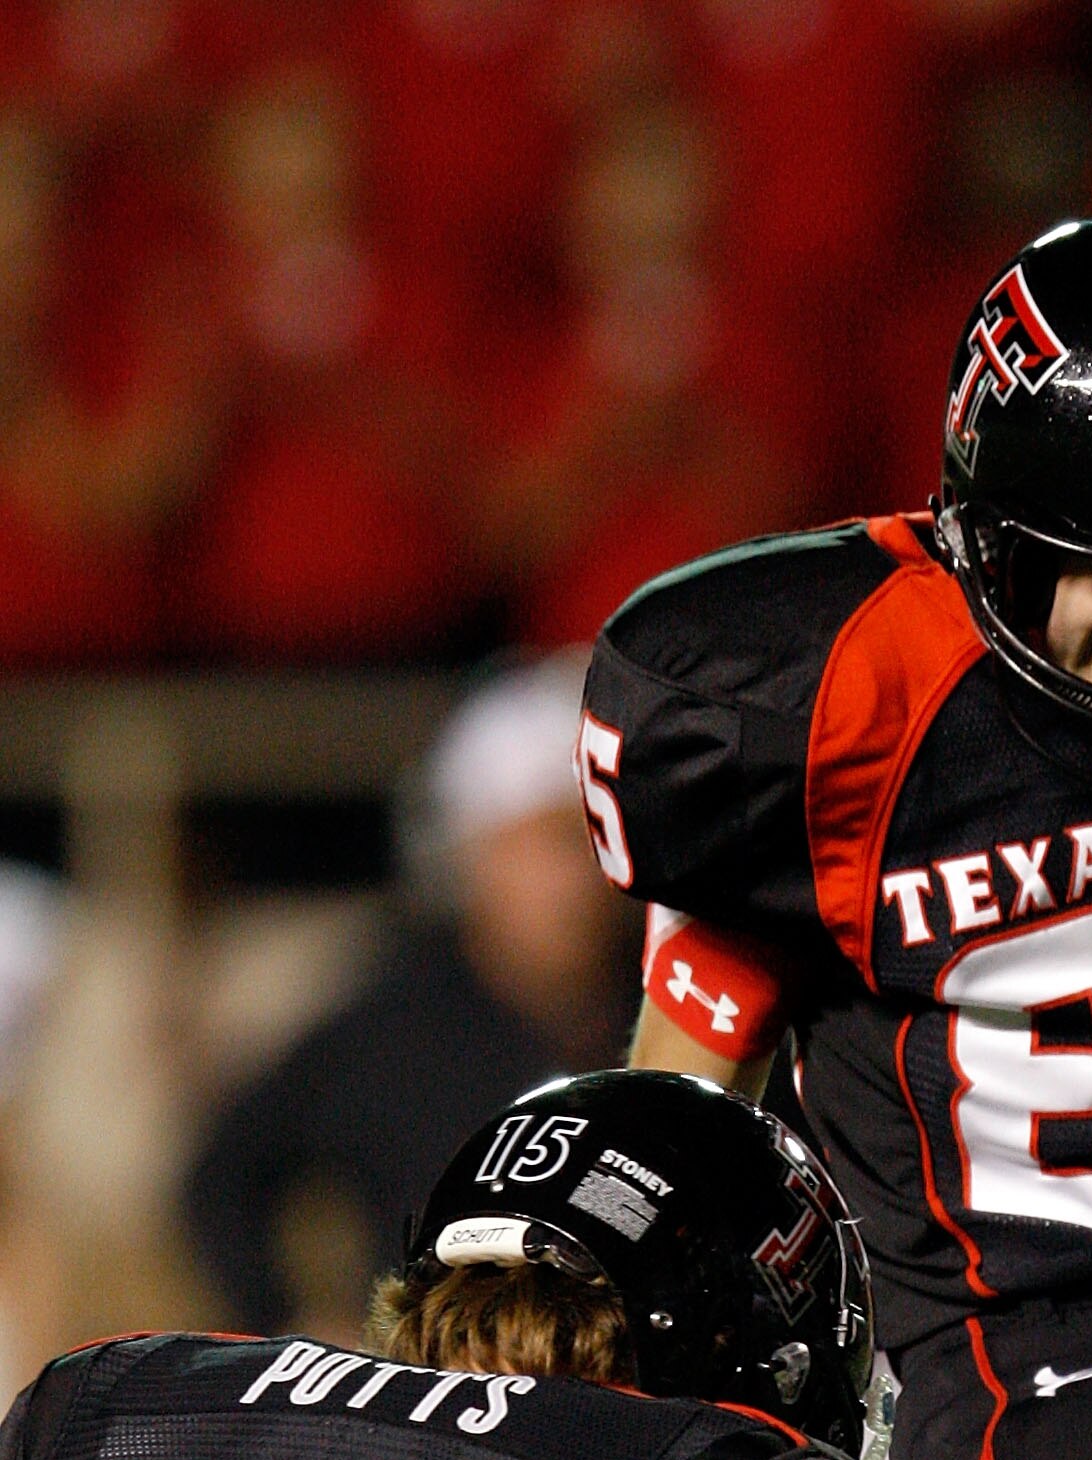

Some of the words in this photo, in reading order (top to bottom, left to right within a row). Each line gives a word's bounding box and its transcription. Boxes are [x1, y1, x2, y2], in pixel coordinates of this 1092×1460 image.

[475, 1115, 588, 1183] 15
[600, 1149, 674, 1197] STONEY
[447, 1227, 515, 1246] SCHUTT
[239, 1340, 537, 1435] POTTS
